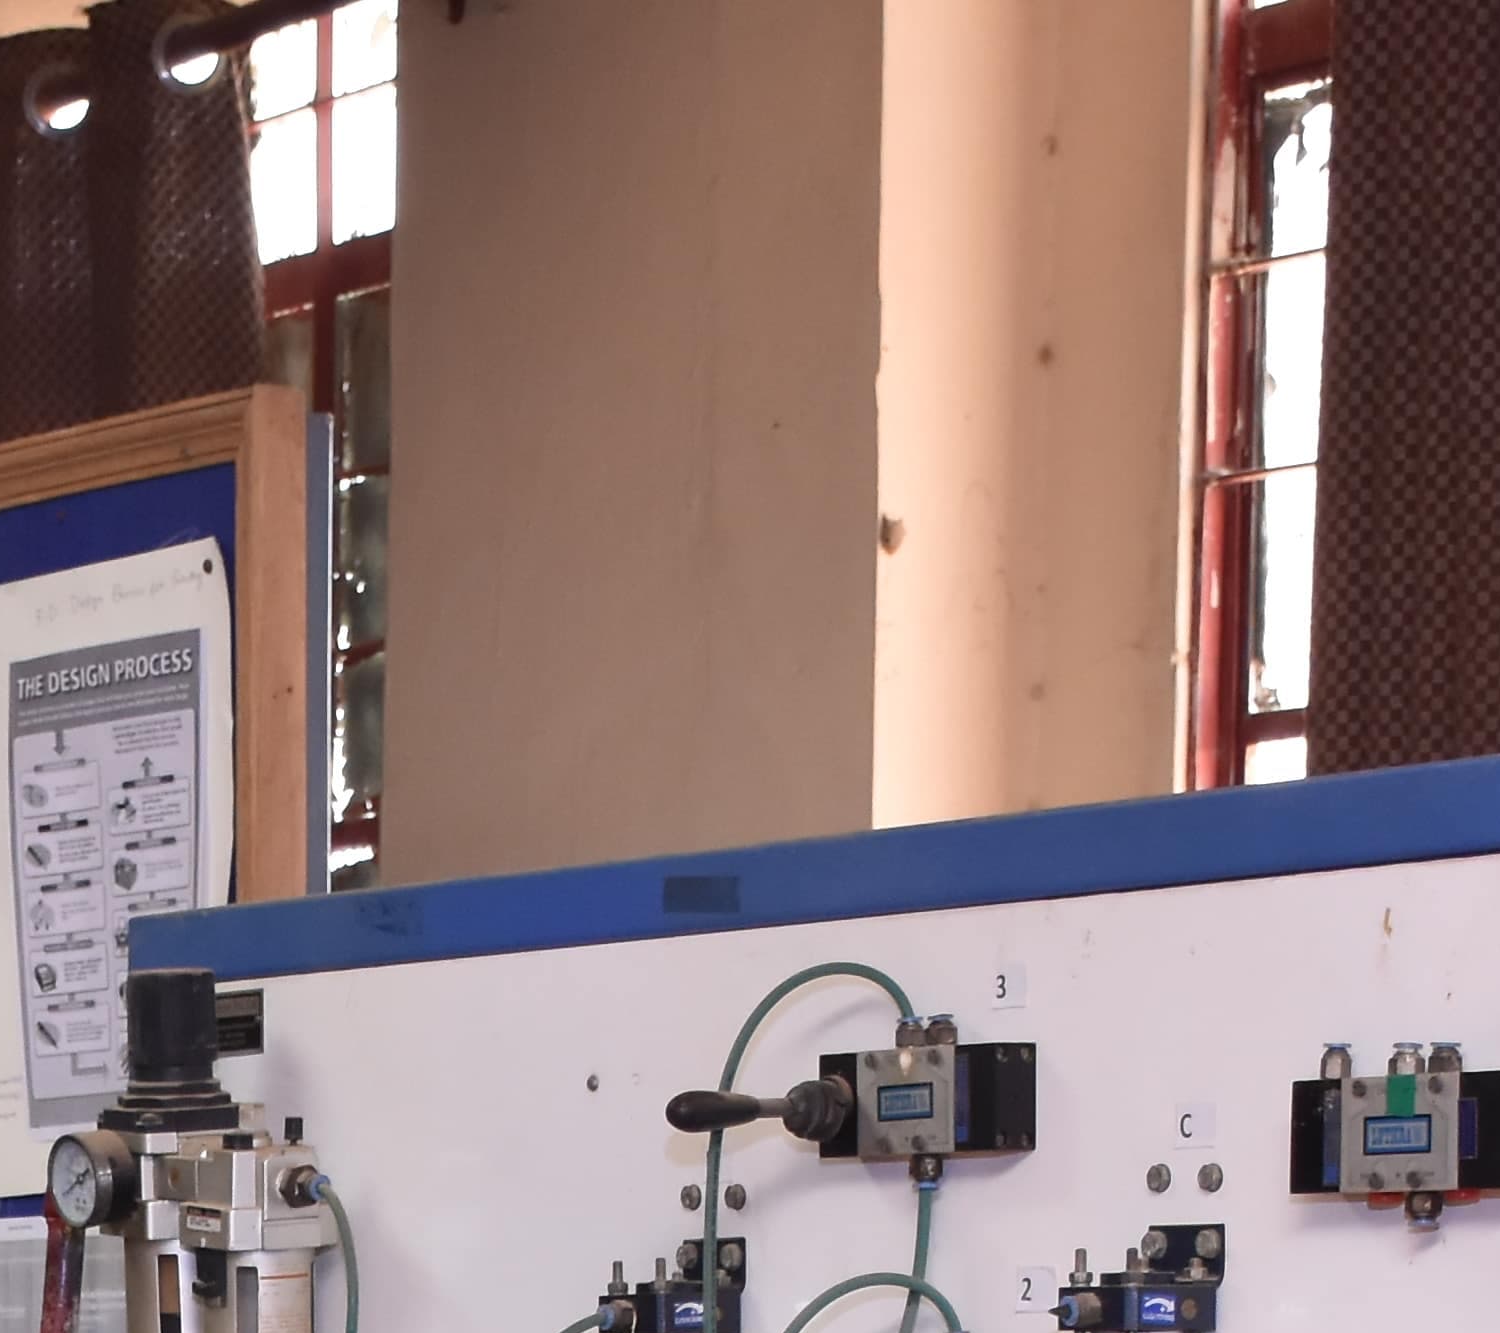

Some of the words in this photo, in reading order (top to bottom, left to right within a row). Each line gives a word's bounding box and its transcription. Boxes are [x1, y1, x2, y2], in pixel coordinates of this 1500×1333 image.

[17, 674, 43, 700] THE
[48, 663, 110, 694] DESIGN
[114, 649, 193, 682] PROCESS
[996, 974, 1007, 999] 3
[1179, 1113, 1193, 1139] C
[1020, 1277, 1032, 1302] 2
